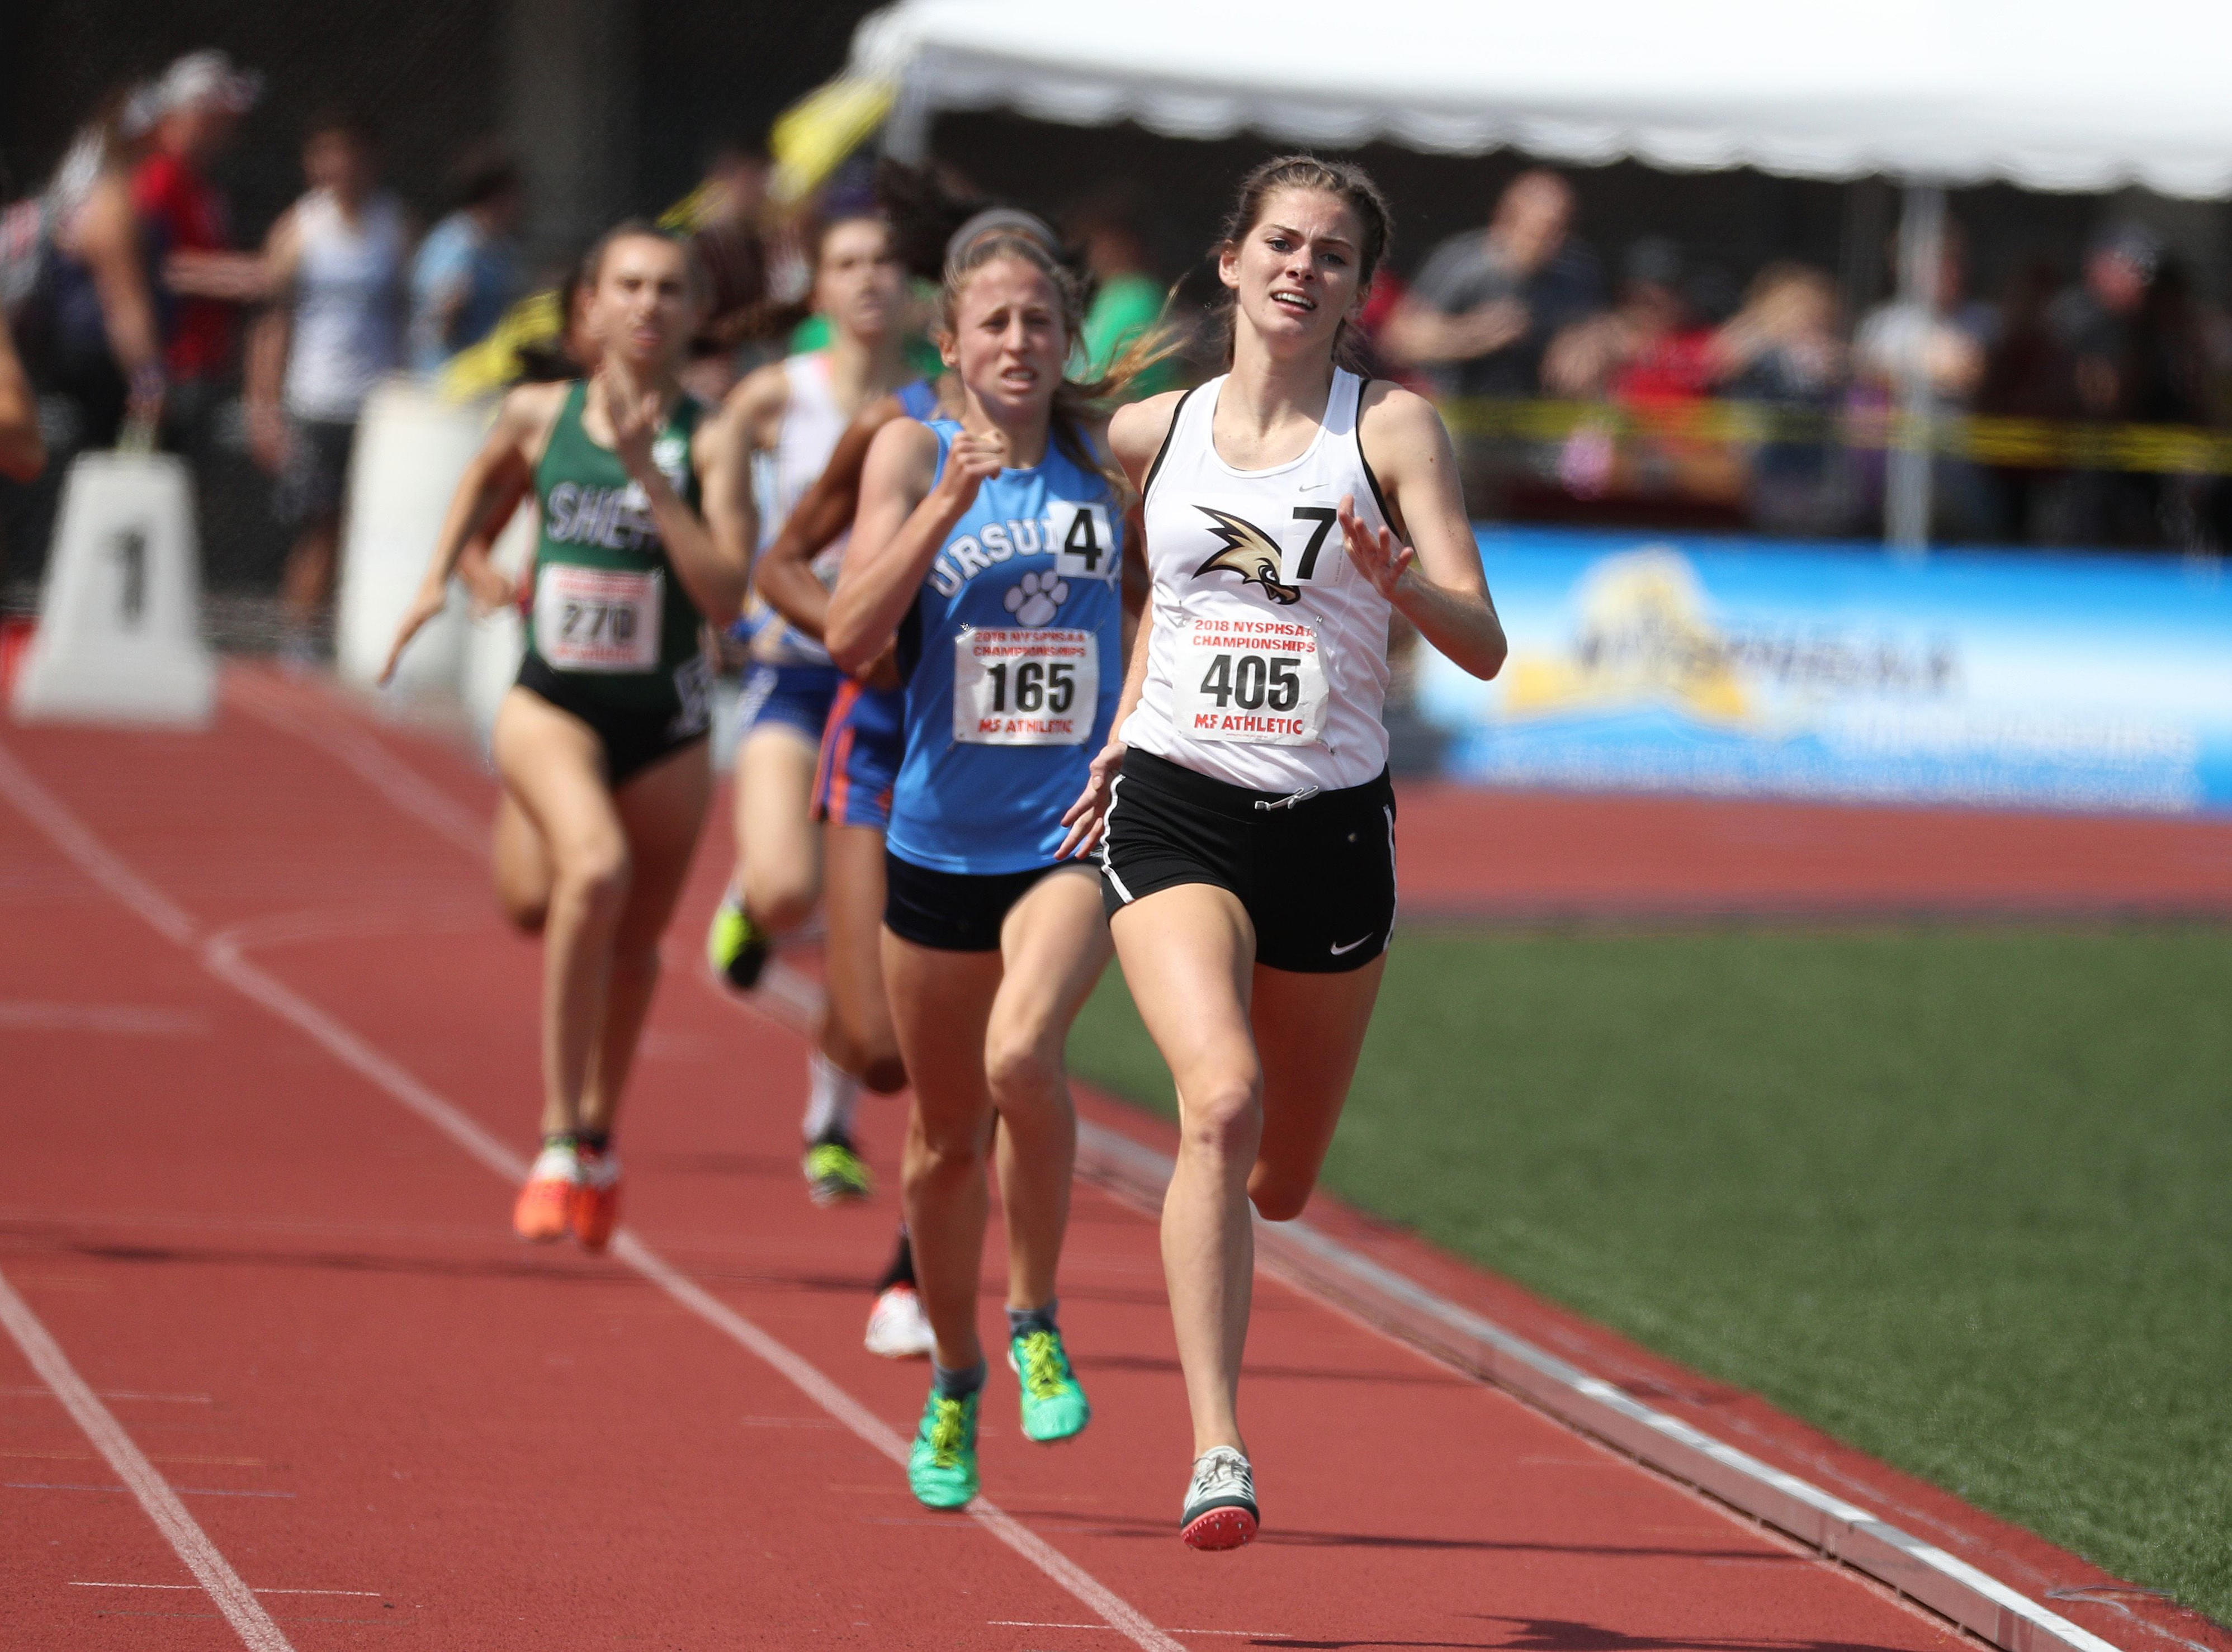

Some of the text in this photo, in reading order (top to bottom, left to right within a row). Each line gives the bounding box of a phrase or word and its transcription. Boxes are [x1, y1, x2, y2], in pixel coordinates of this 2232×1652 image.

[1065, 509, 1102, 570] 4
[1292, 507, 1337, 580] 7
[96, 521, 148, 635] 1
[975, 631, 1006, 642] 2018
[1194, 619, 1316, 637] 2018 NYSPHSAA
[973, 646, 1086, 657] CHAMPIONSHIPS
[1193, 635, 1316, 653] CHAMPIONSHIPS
[987, 662, 1076, 713] 165
[1200, 654, 1301, 712] 405
[1005, 720, 1074, 733] ATHLETIC
[1221, 715, 1303, 735] ATHLETIC
